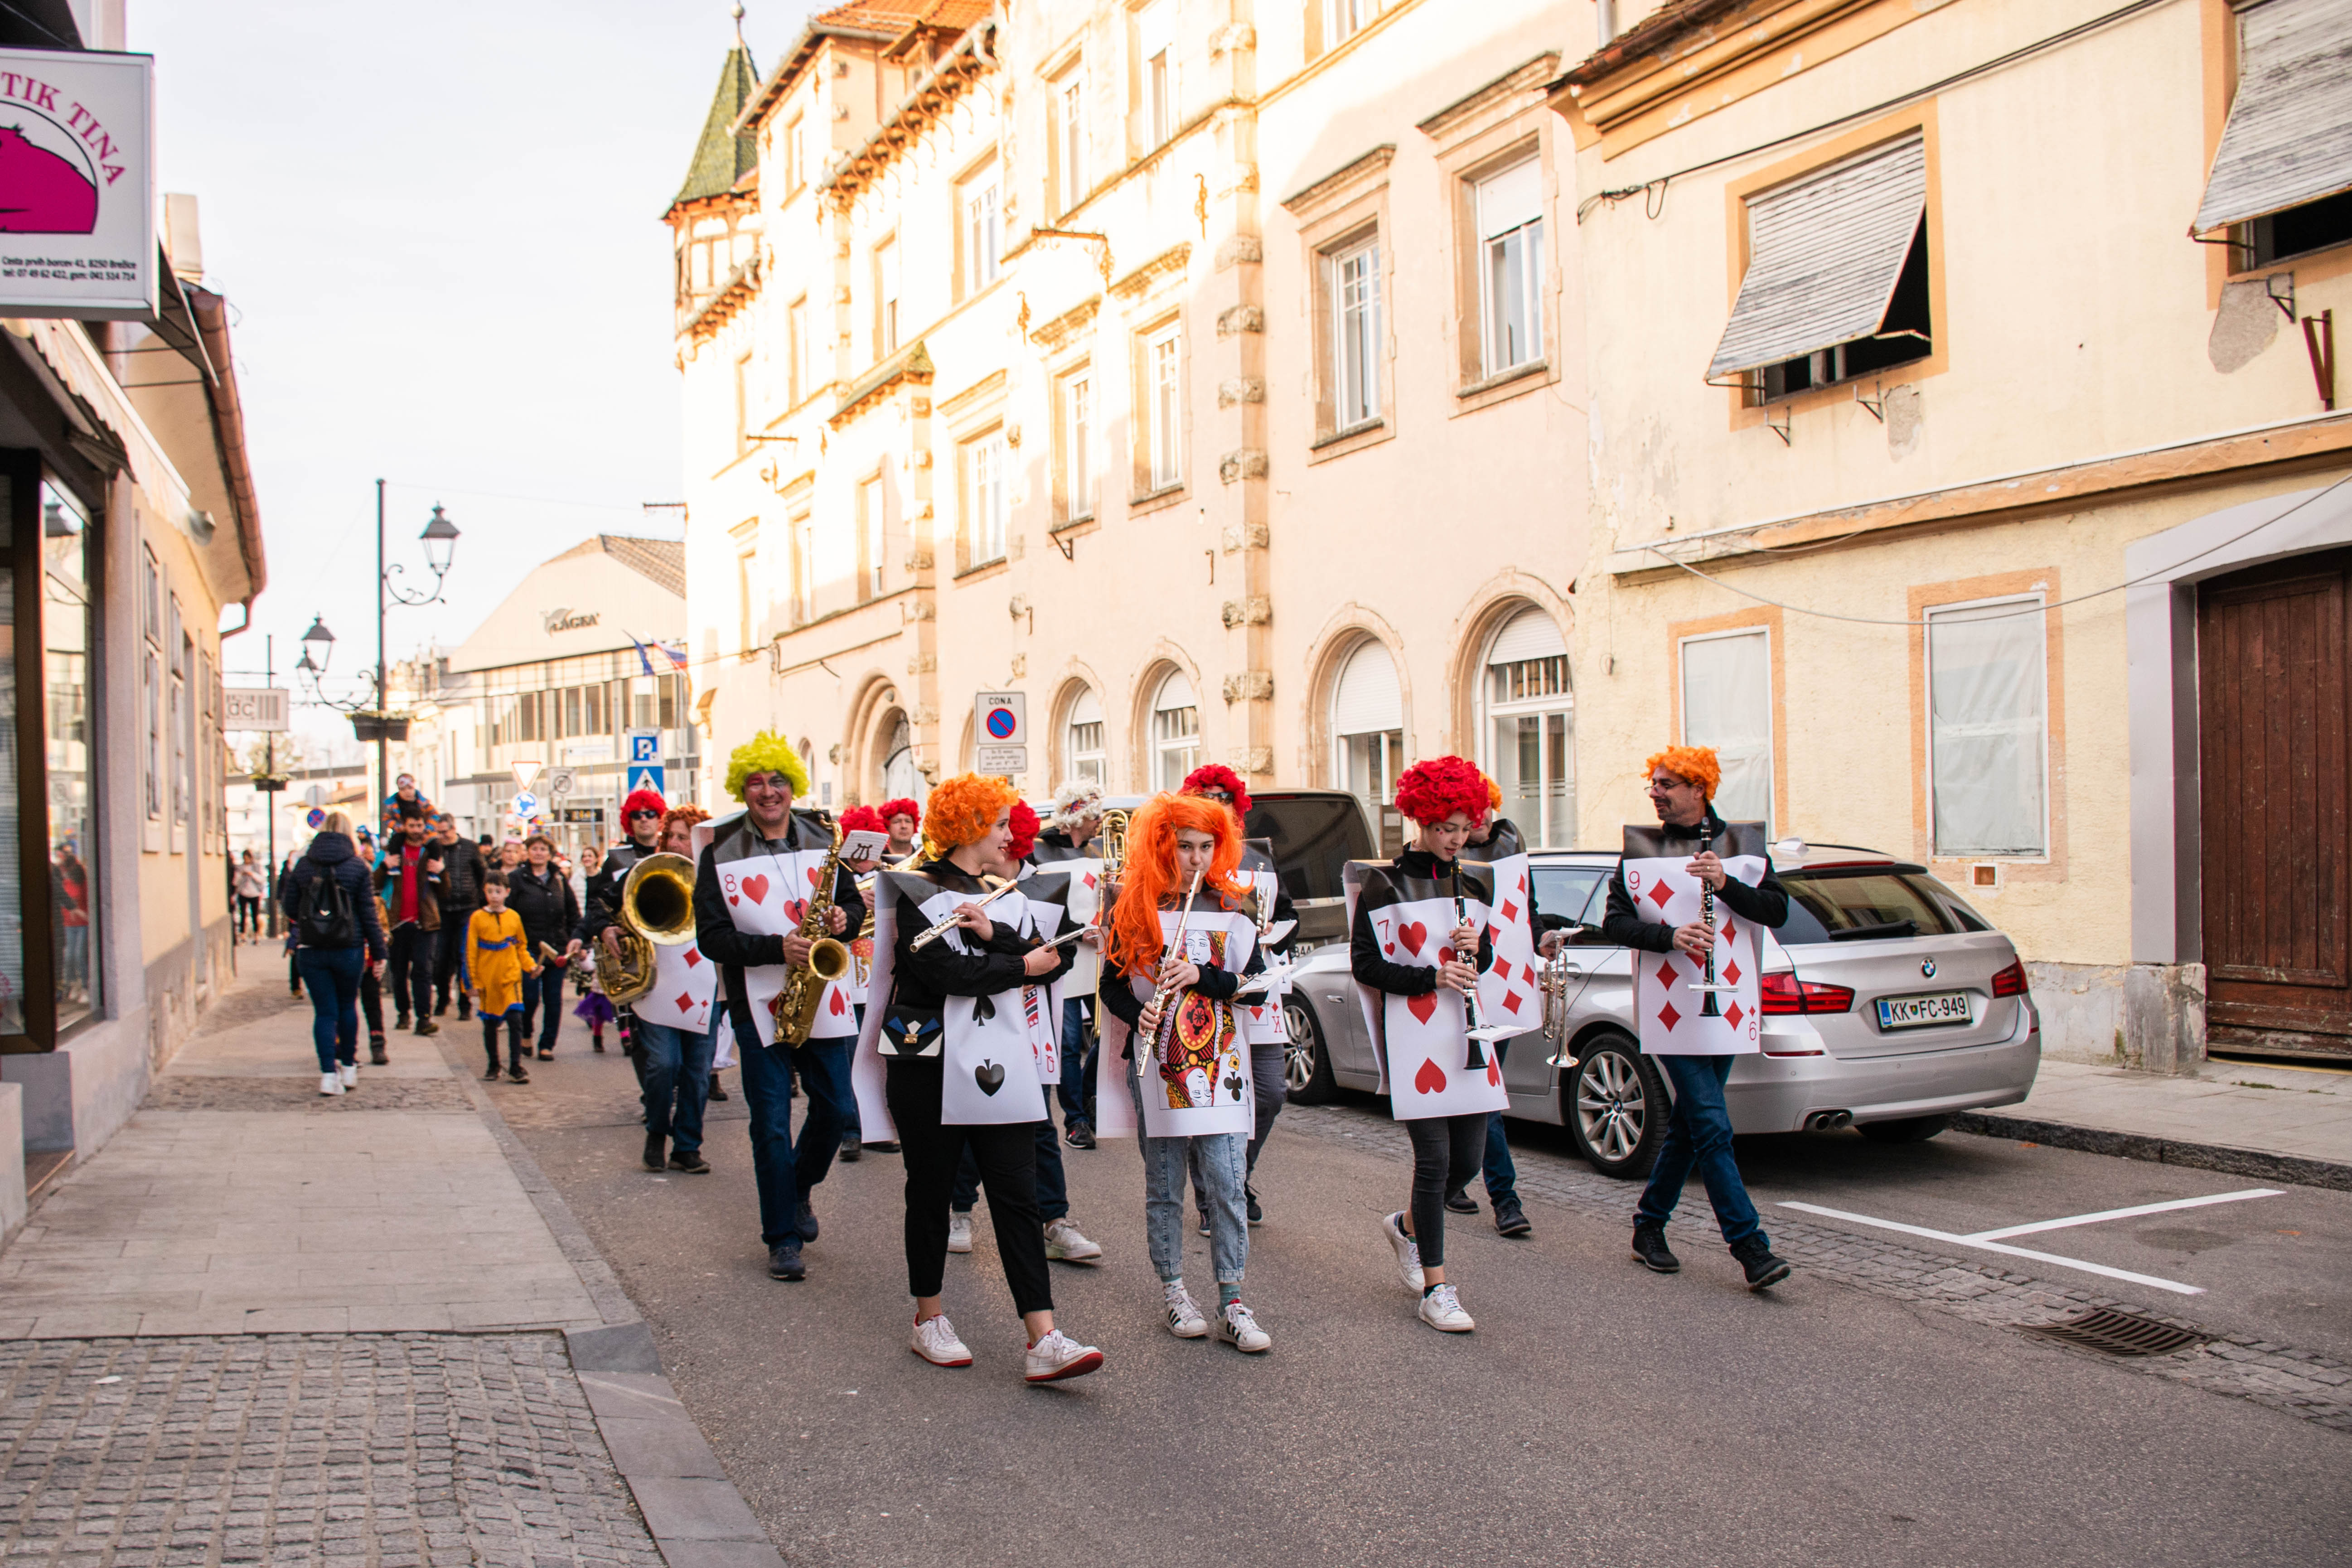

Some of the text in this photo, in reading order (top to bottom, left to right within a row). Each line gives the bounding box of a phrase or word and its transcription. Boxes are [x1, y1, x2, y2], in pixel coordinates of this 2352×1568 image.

[66, 101, 126, 187] TINA
[638, 739, 653, 759] P
[725, 874, 737, 892] 8
[1629, 871, 1640, 890] 9
[1377, 919, 1389, 940] 7
[1890, 997, 1966, 1021] KK FC-949
